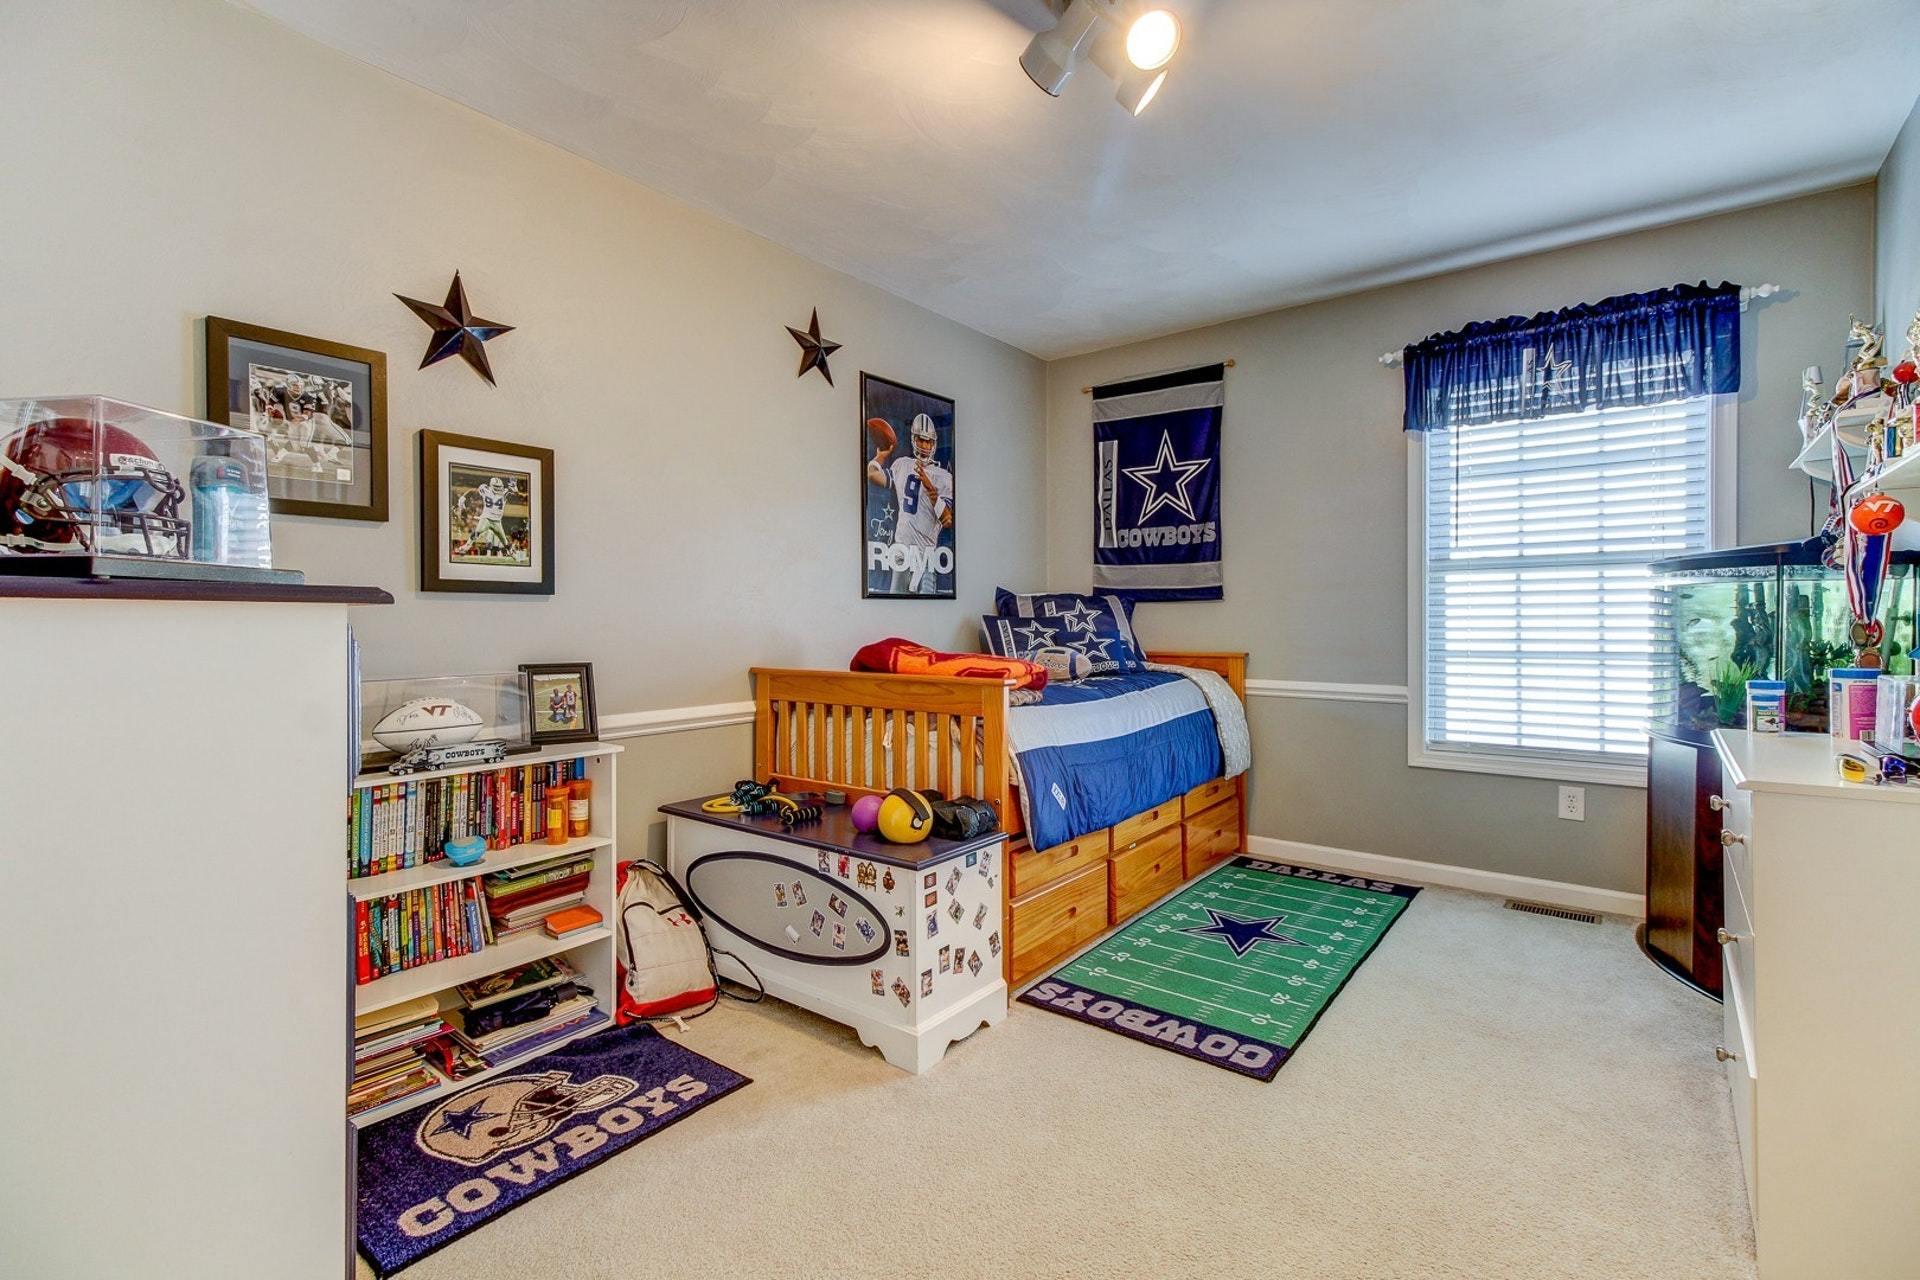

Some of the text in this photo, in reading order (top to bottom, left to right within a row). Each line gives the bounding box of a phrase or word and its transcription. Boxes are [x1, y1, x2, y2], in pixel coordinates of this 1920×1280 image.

[903, 473, 921, 515] 9
[1102, 459, 1114, 531] DALLAS
[1866, 500, 1897, 513] VT
[1117, 521, 1217, 549] COWBOYS
[867, 540, 954, 575] ROMO
[422, 704, 453, 717] VT
[445, 748, 485, 760] COWBOYS
[1245, 860, 1396, 893] DALLAS
[1112, 952, 1131, 963] 20
[1089, 967, 1109, 977] 10
[1270, 992, 1290, 1006] 20
[1026, 981, 1275, 1070] COWBOYS
[1251, 1013, 1272, 1026] 10
[398, 1073, 709, 1238] COWBOYS
